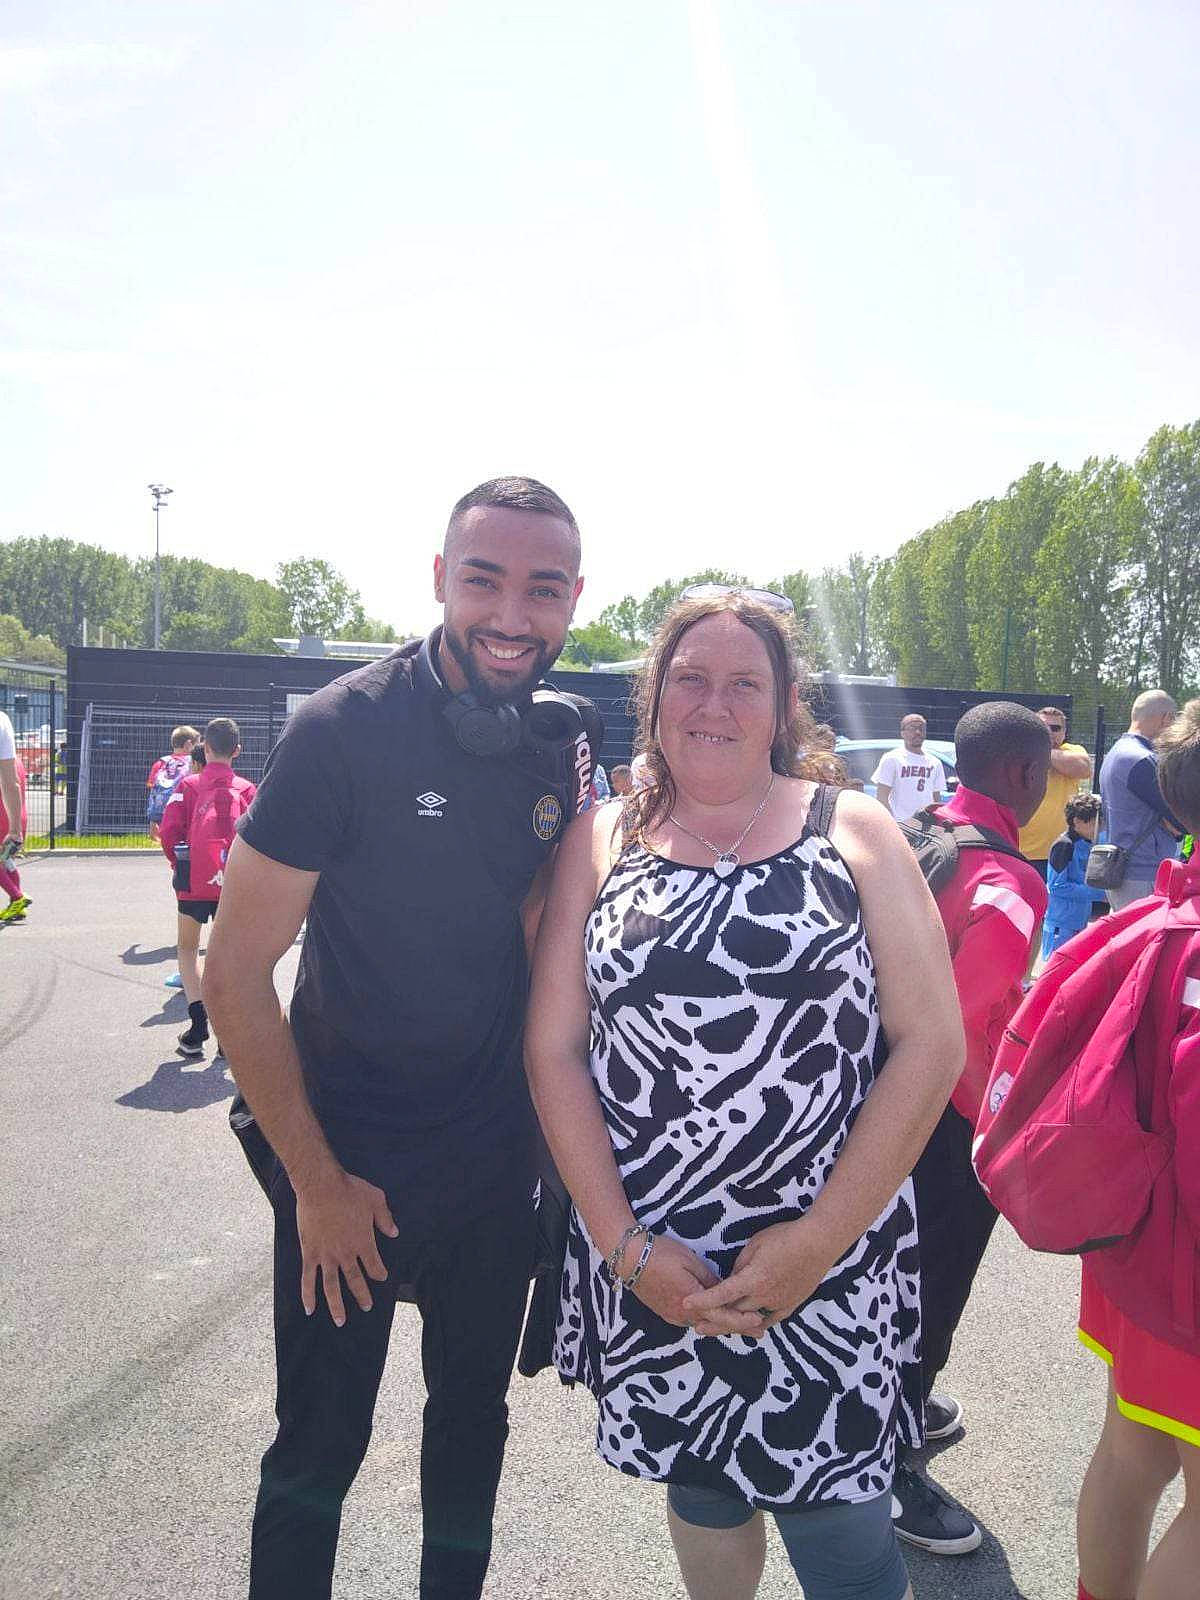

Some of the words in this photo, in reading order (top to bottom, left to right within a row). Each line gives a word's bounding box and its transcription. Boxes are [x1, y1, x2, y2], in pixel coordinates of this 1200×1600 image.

[901, 765, 934, 778] HEAT
[916, 778, 925, 792] 6
[417, 808, 443, 817] umbro
